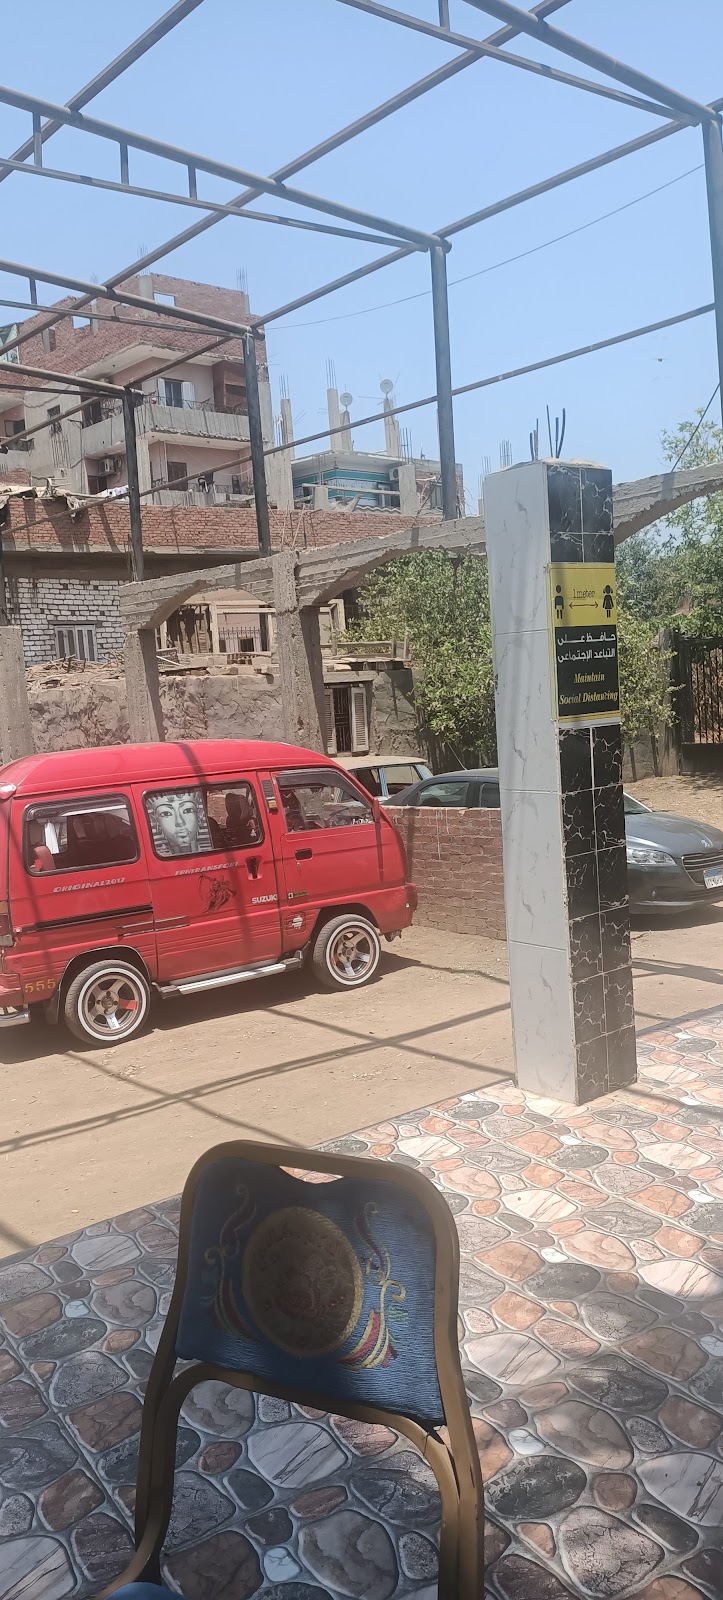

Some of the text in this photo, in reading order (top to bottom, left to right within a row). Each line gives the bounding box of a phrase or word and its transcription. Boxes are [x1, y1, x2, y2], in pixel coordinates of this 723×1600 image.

[594, 648, 615, 660] التباعد
[574, 672, 605, 684] Maintain
[559, 691, 618, 705] Social Distancing
[251, 893, 279, 905] SUZUKI
[24, 977, 56, 994] 555
